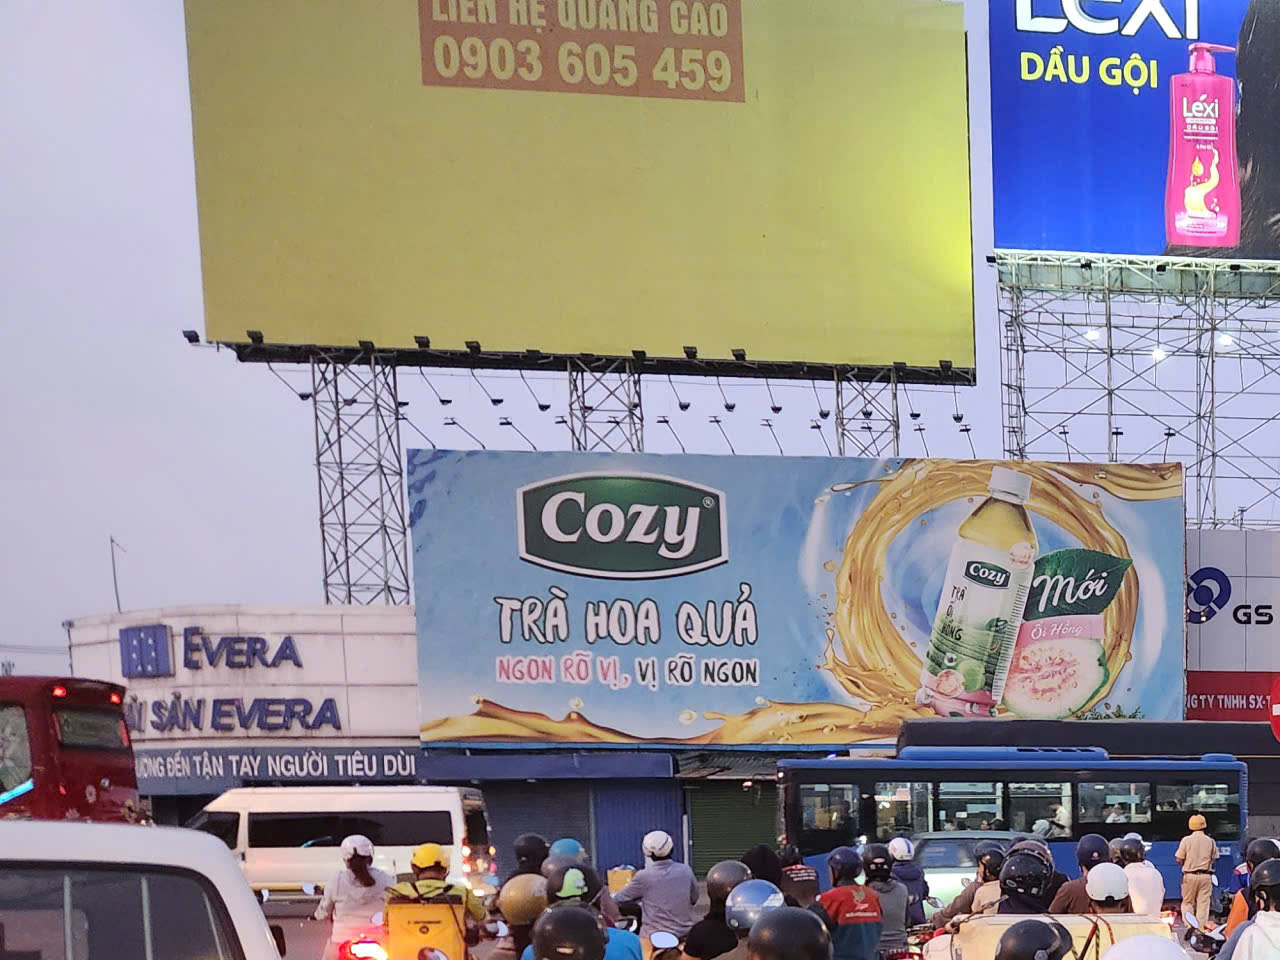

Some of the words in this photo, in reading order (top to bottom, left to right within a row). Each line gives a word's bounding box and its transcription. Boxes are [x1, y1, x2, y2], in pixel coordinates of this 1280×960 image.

[433, 35, 543, 81] 0903
[557, 41, 638, 87] 605
[653, 47, 732, 92] 459
[1020, 45, 1090, 84] DẦU
[1099, 53, 1158, 95] GỘI
[541, 491, 700, 559] Cozy
[969, 564, 1006, 585] Cozy
[1033, 568, 1108, 613] Mới
[495, 586, 569, 643] TRÀ
[585, 599, 660, 644] HOA
[677, 583, 758, 646] QUẢ
[1233, 604, 1273, 625] GS
[184, 626, 302, 669] EVERA
[499, 657, 553, 681] NGON
[563, 653, 589, 680] RÕ
[638, 659, 658, 688] VỊ
[668, 655, 694, 682] RÕ
[704, 660, 757, 683] NGON
[150, 692, 205, 732] SẢN
[211, 698, 341, 731] EVERA
[1200, 694, 1216, 709] TY
[1217, 694, 1246, 709] TNHH
[193, 750, 224, 780] TẬN
[228, 755, 260, 777] TAY
[267, 752, 328, 777] NGƯỜI
[334, 751, 377, 777] TIÊU
